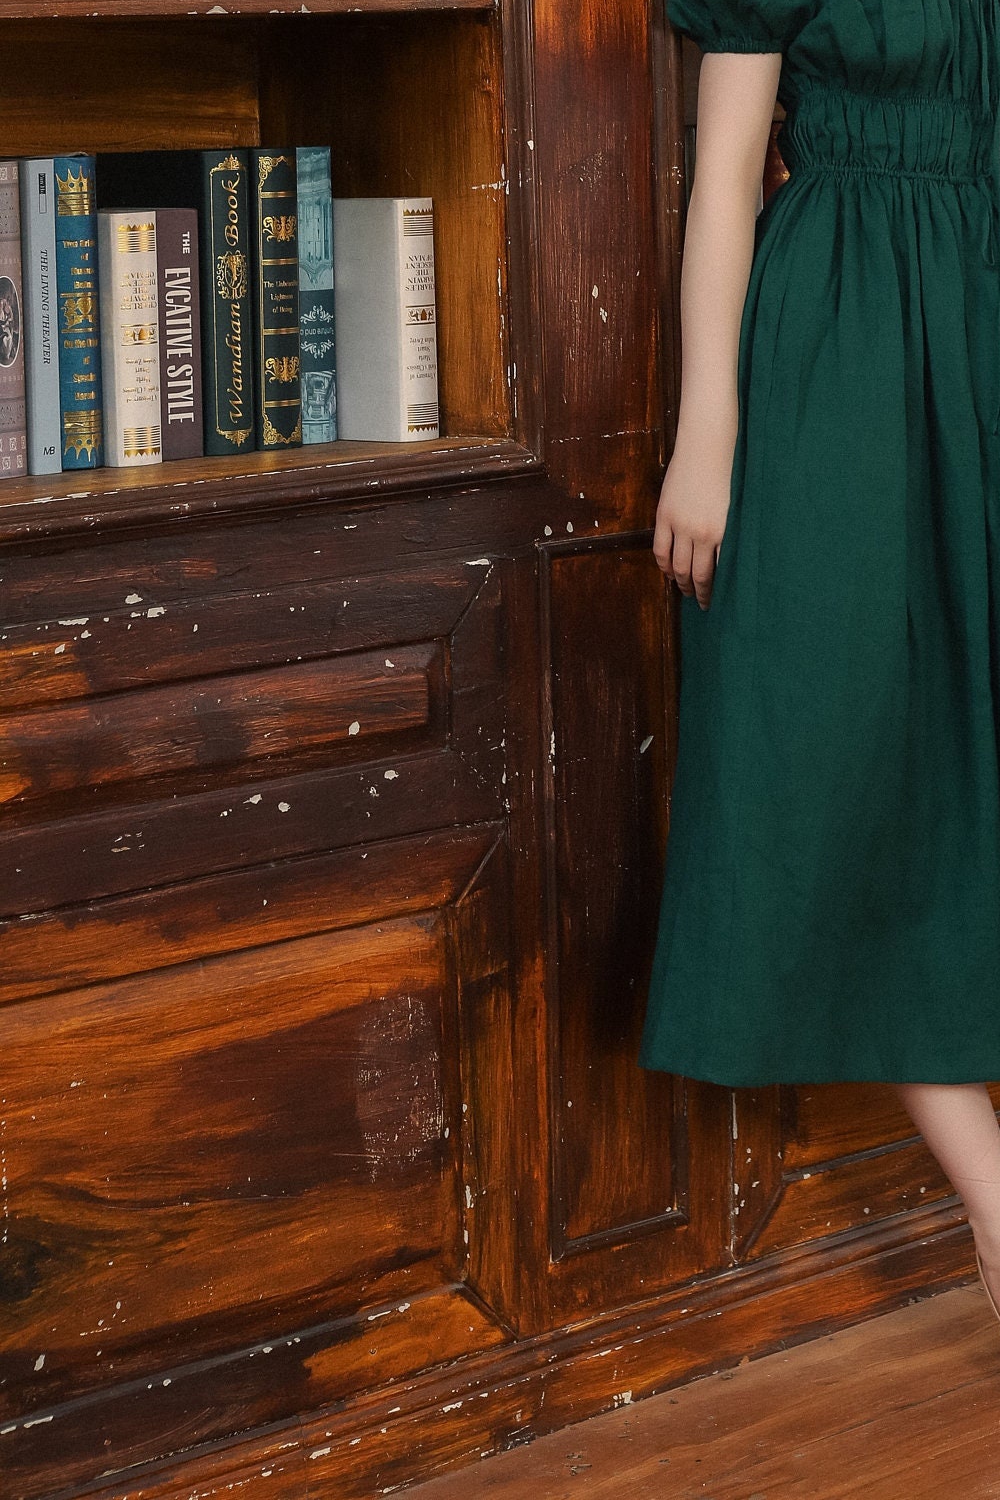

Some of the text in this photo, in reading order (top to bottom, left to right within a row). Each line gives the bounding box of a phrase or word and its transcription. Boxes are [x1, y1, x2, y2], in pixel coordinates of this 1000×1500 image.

[182, 231, 190, 254] THE
[40, 249, 51, 365] THE LIVING THEATER
[221, 172, 243, 424] Wandian Book
[166, 364, 195, 424] STYLE
